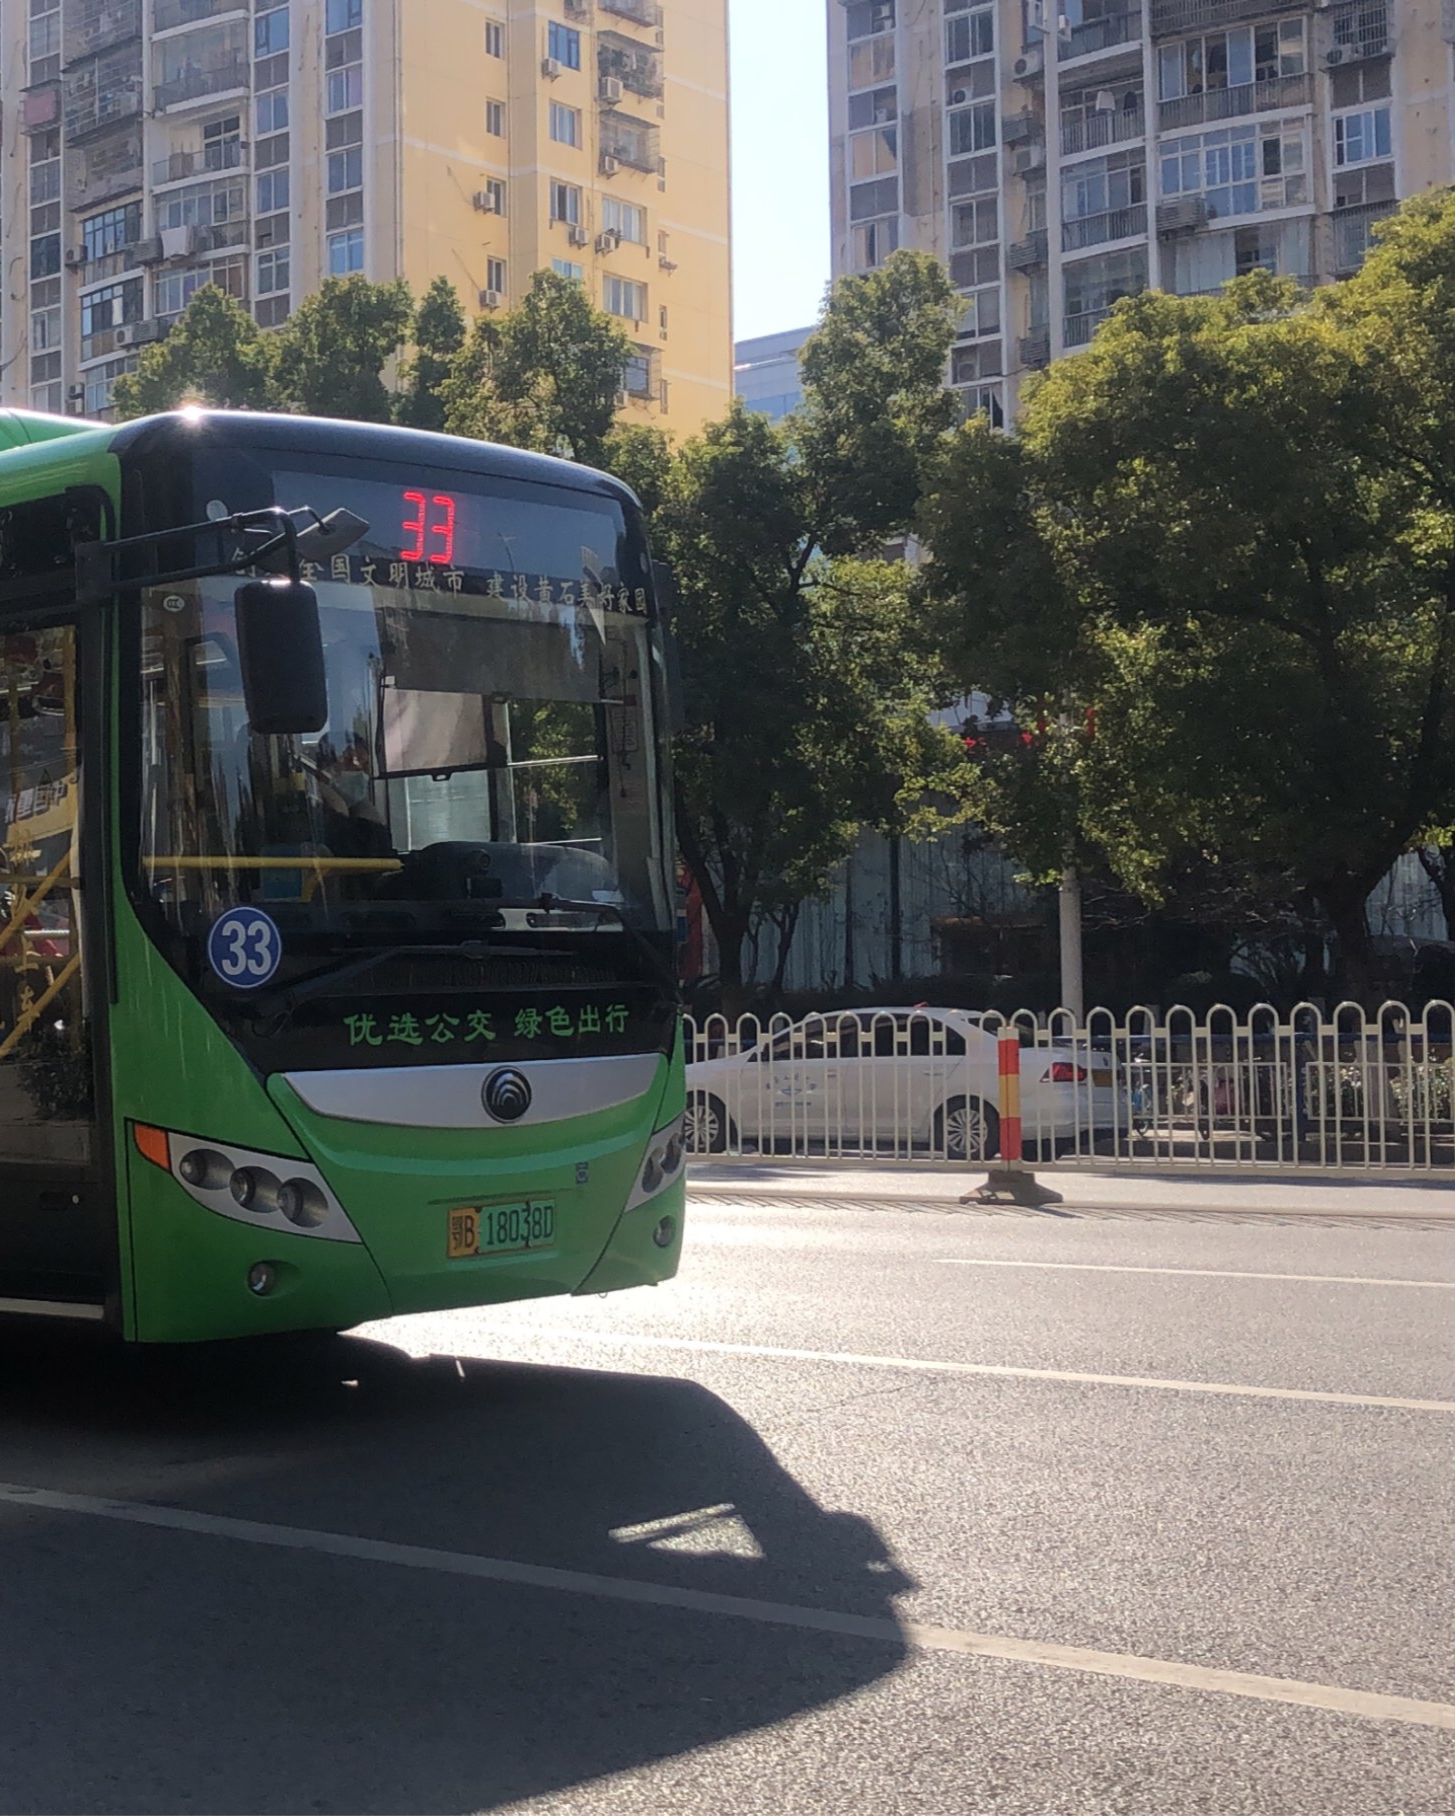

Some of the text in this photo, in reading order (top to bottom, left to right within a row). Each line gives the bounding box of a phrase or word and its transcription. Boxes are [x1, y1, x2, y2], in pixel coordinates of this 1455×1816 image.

[399, 490, 457, 565] 33
[221, 920, 273, 976] 33
[343, 1003, 630, 1047] 优选公交 绿色出行
[452, 1205, 554, 1251] 鄂B 18038D
